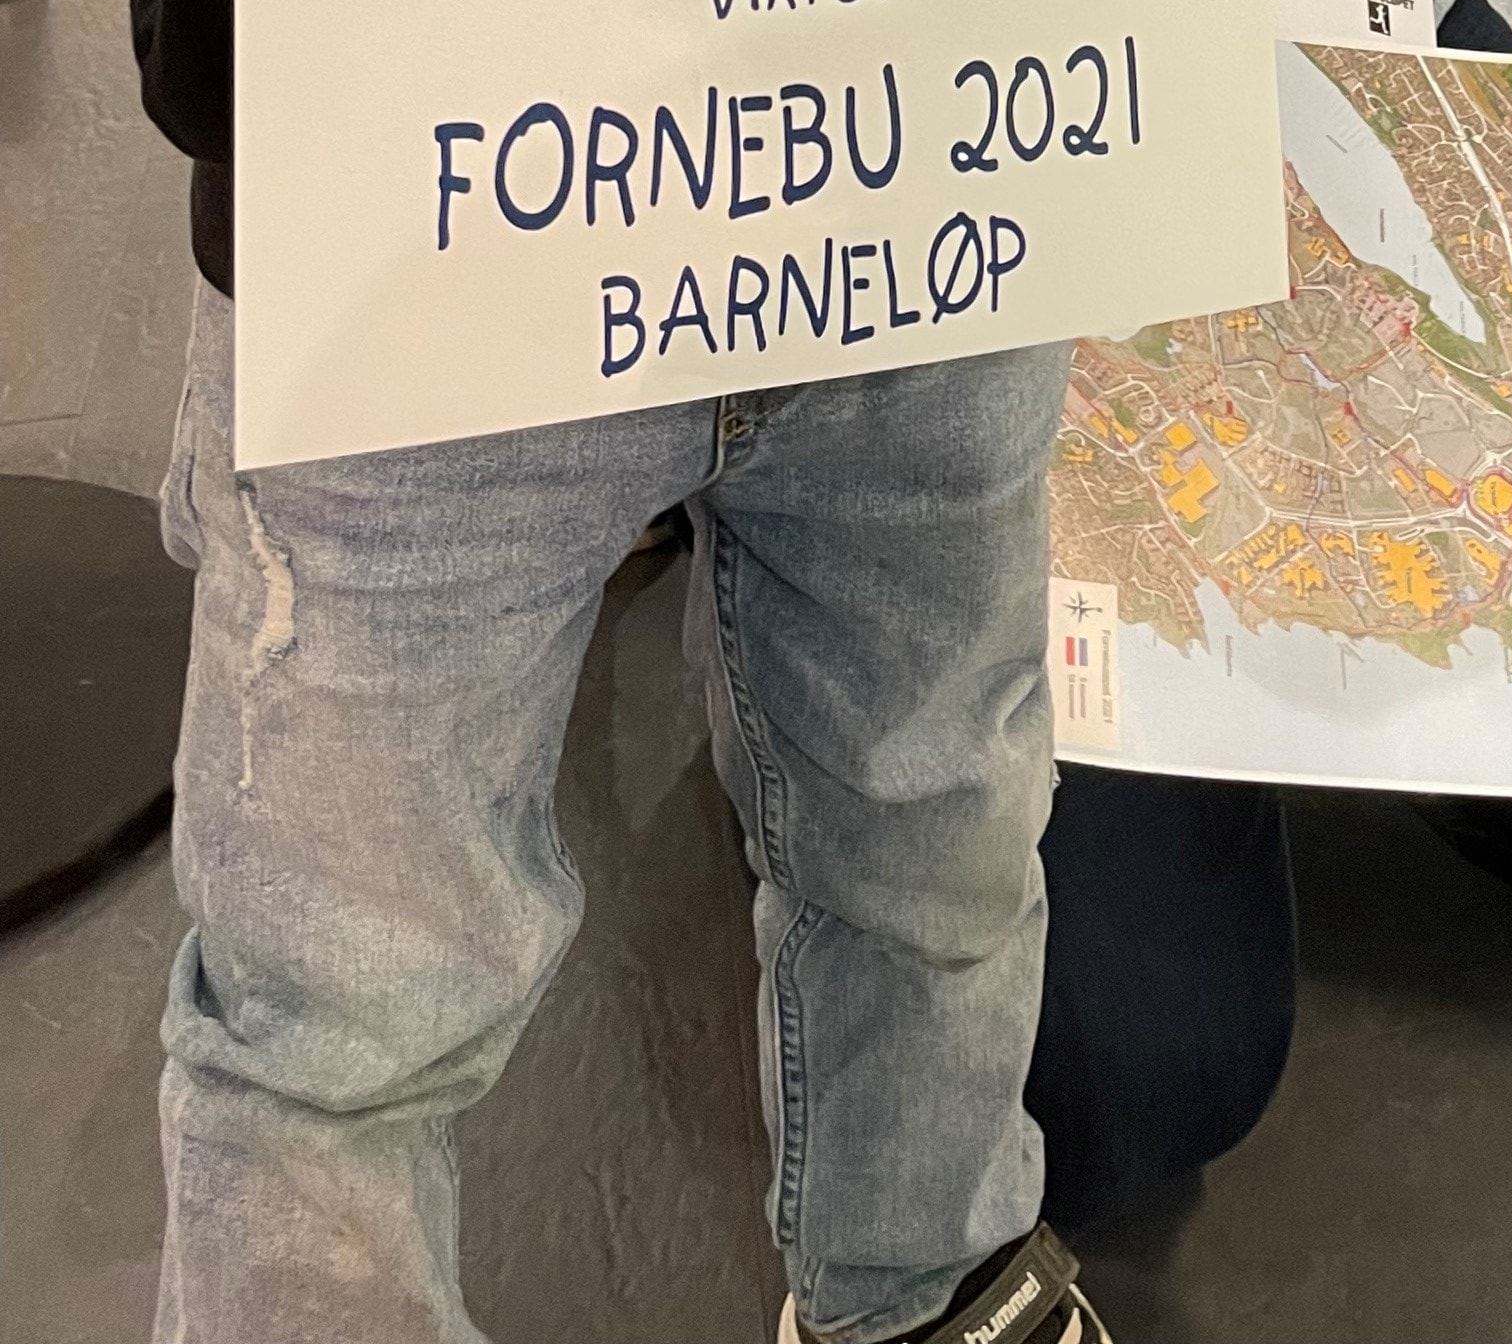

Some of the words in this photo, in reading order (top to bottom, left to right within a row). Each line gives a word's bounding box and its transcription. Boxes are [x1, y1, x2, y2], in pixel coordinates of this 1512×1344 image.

[434, 63, 902, 251] FORNEBU
[950, 36, 1141, 173] 2021
[600, 211, 1027, 379] BARNELØP
[963, 1270, 1042, 1344] hummel
